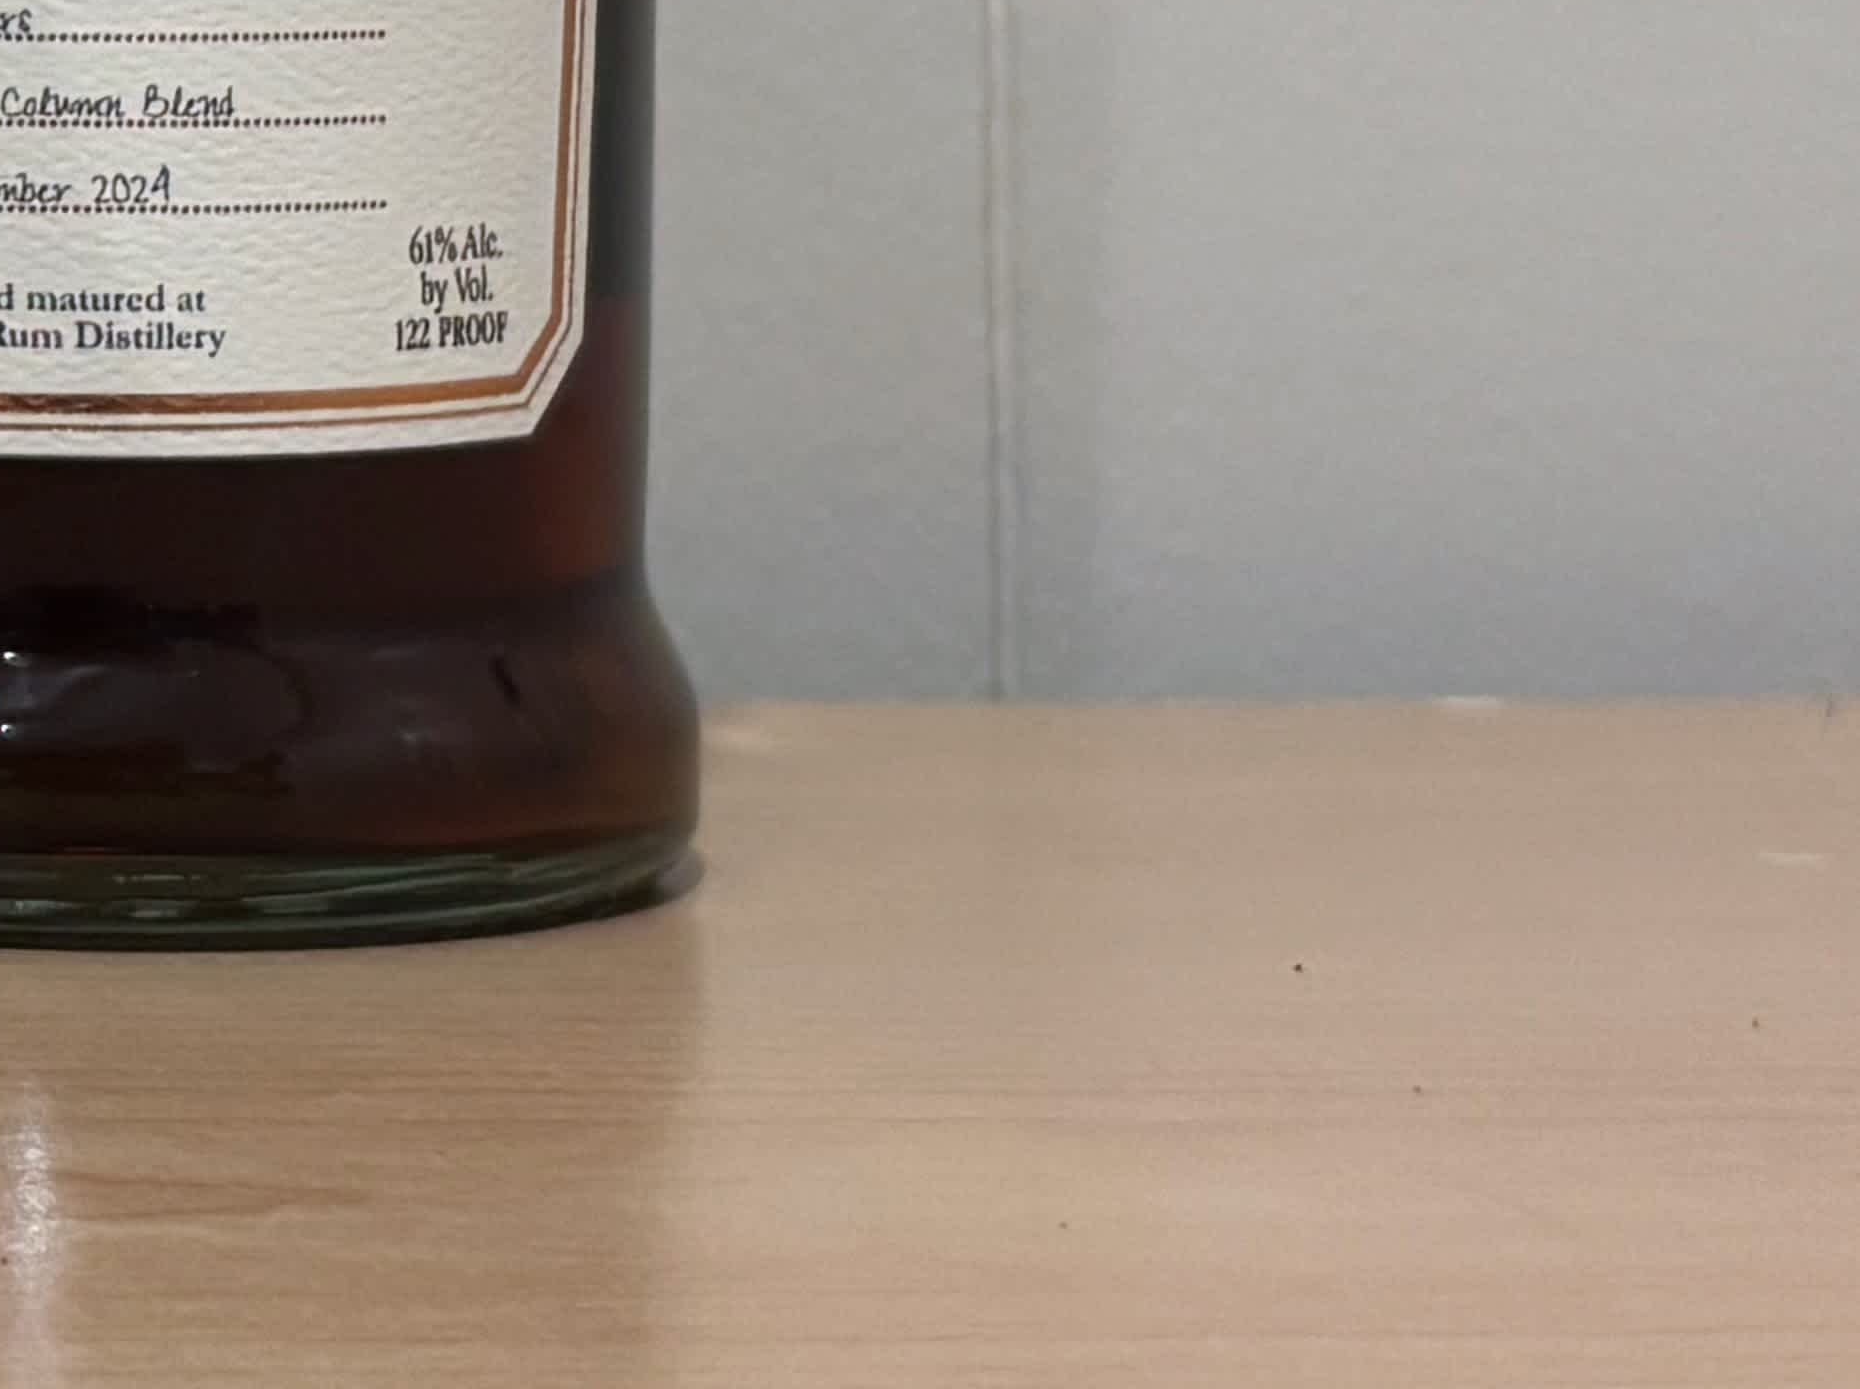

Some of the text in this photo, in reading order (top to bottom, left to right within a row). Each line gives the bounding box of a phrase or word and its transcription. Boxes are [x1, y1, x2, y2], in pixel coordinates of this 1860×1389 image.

[0, 84, 126, 119] Column
[142, 83, 235, 119] Blend
[91, 164, 171, 204] 2024
[408, 221, 504, 264] 61% Alc.
[26, 283, 165, 312] matured
[176, 286, 206, 312] at
[420, 262, 494, 314] by Vol.
[74, 320, 227, 358] Distillery
[395, 310, 509, 351] 122 PROOF
